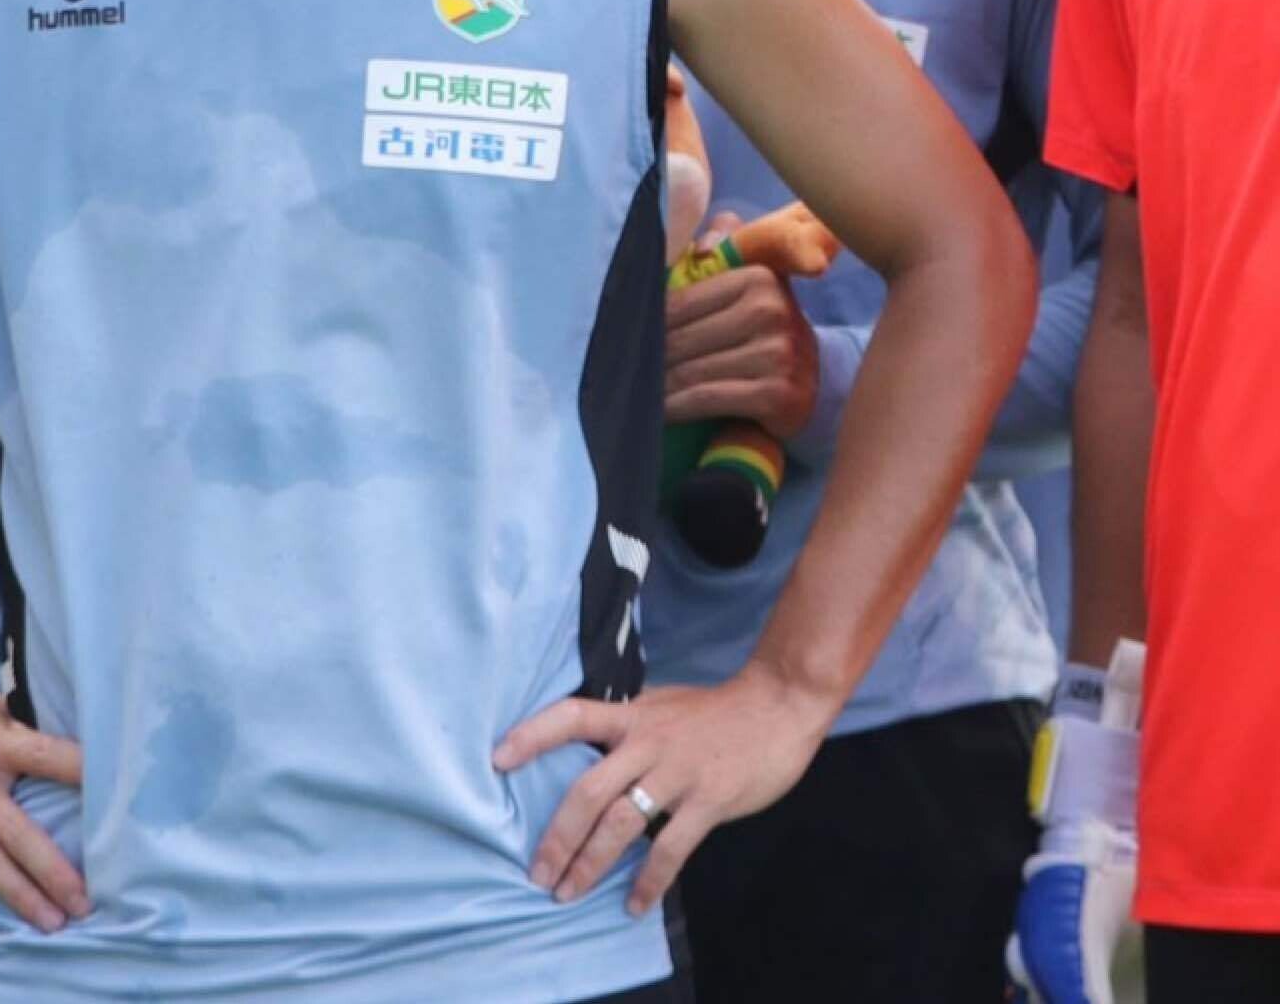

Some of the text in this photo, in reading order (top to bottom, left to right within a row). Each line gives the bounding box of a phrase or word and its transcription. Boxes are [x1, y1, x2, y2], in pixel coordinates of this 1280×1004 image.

[27, 1, 126, 32] hummel
[382, 71, 552, 113] JR東日本
[377, 127, 548, 170] 古河電工
